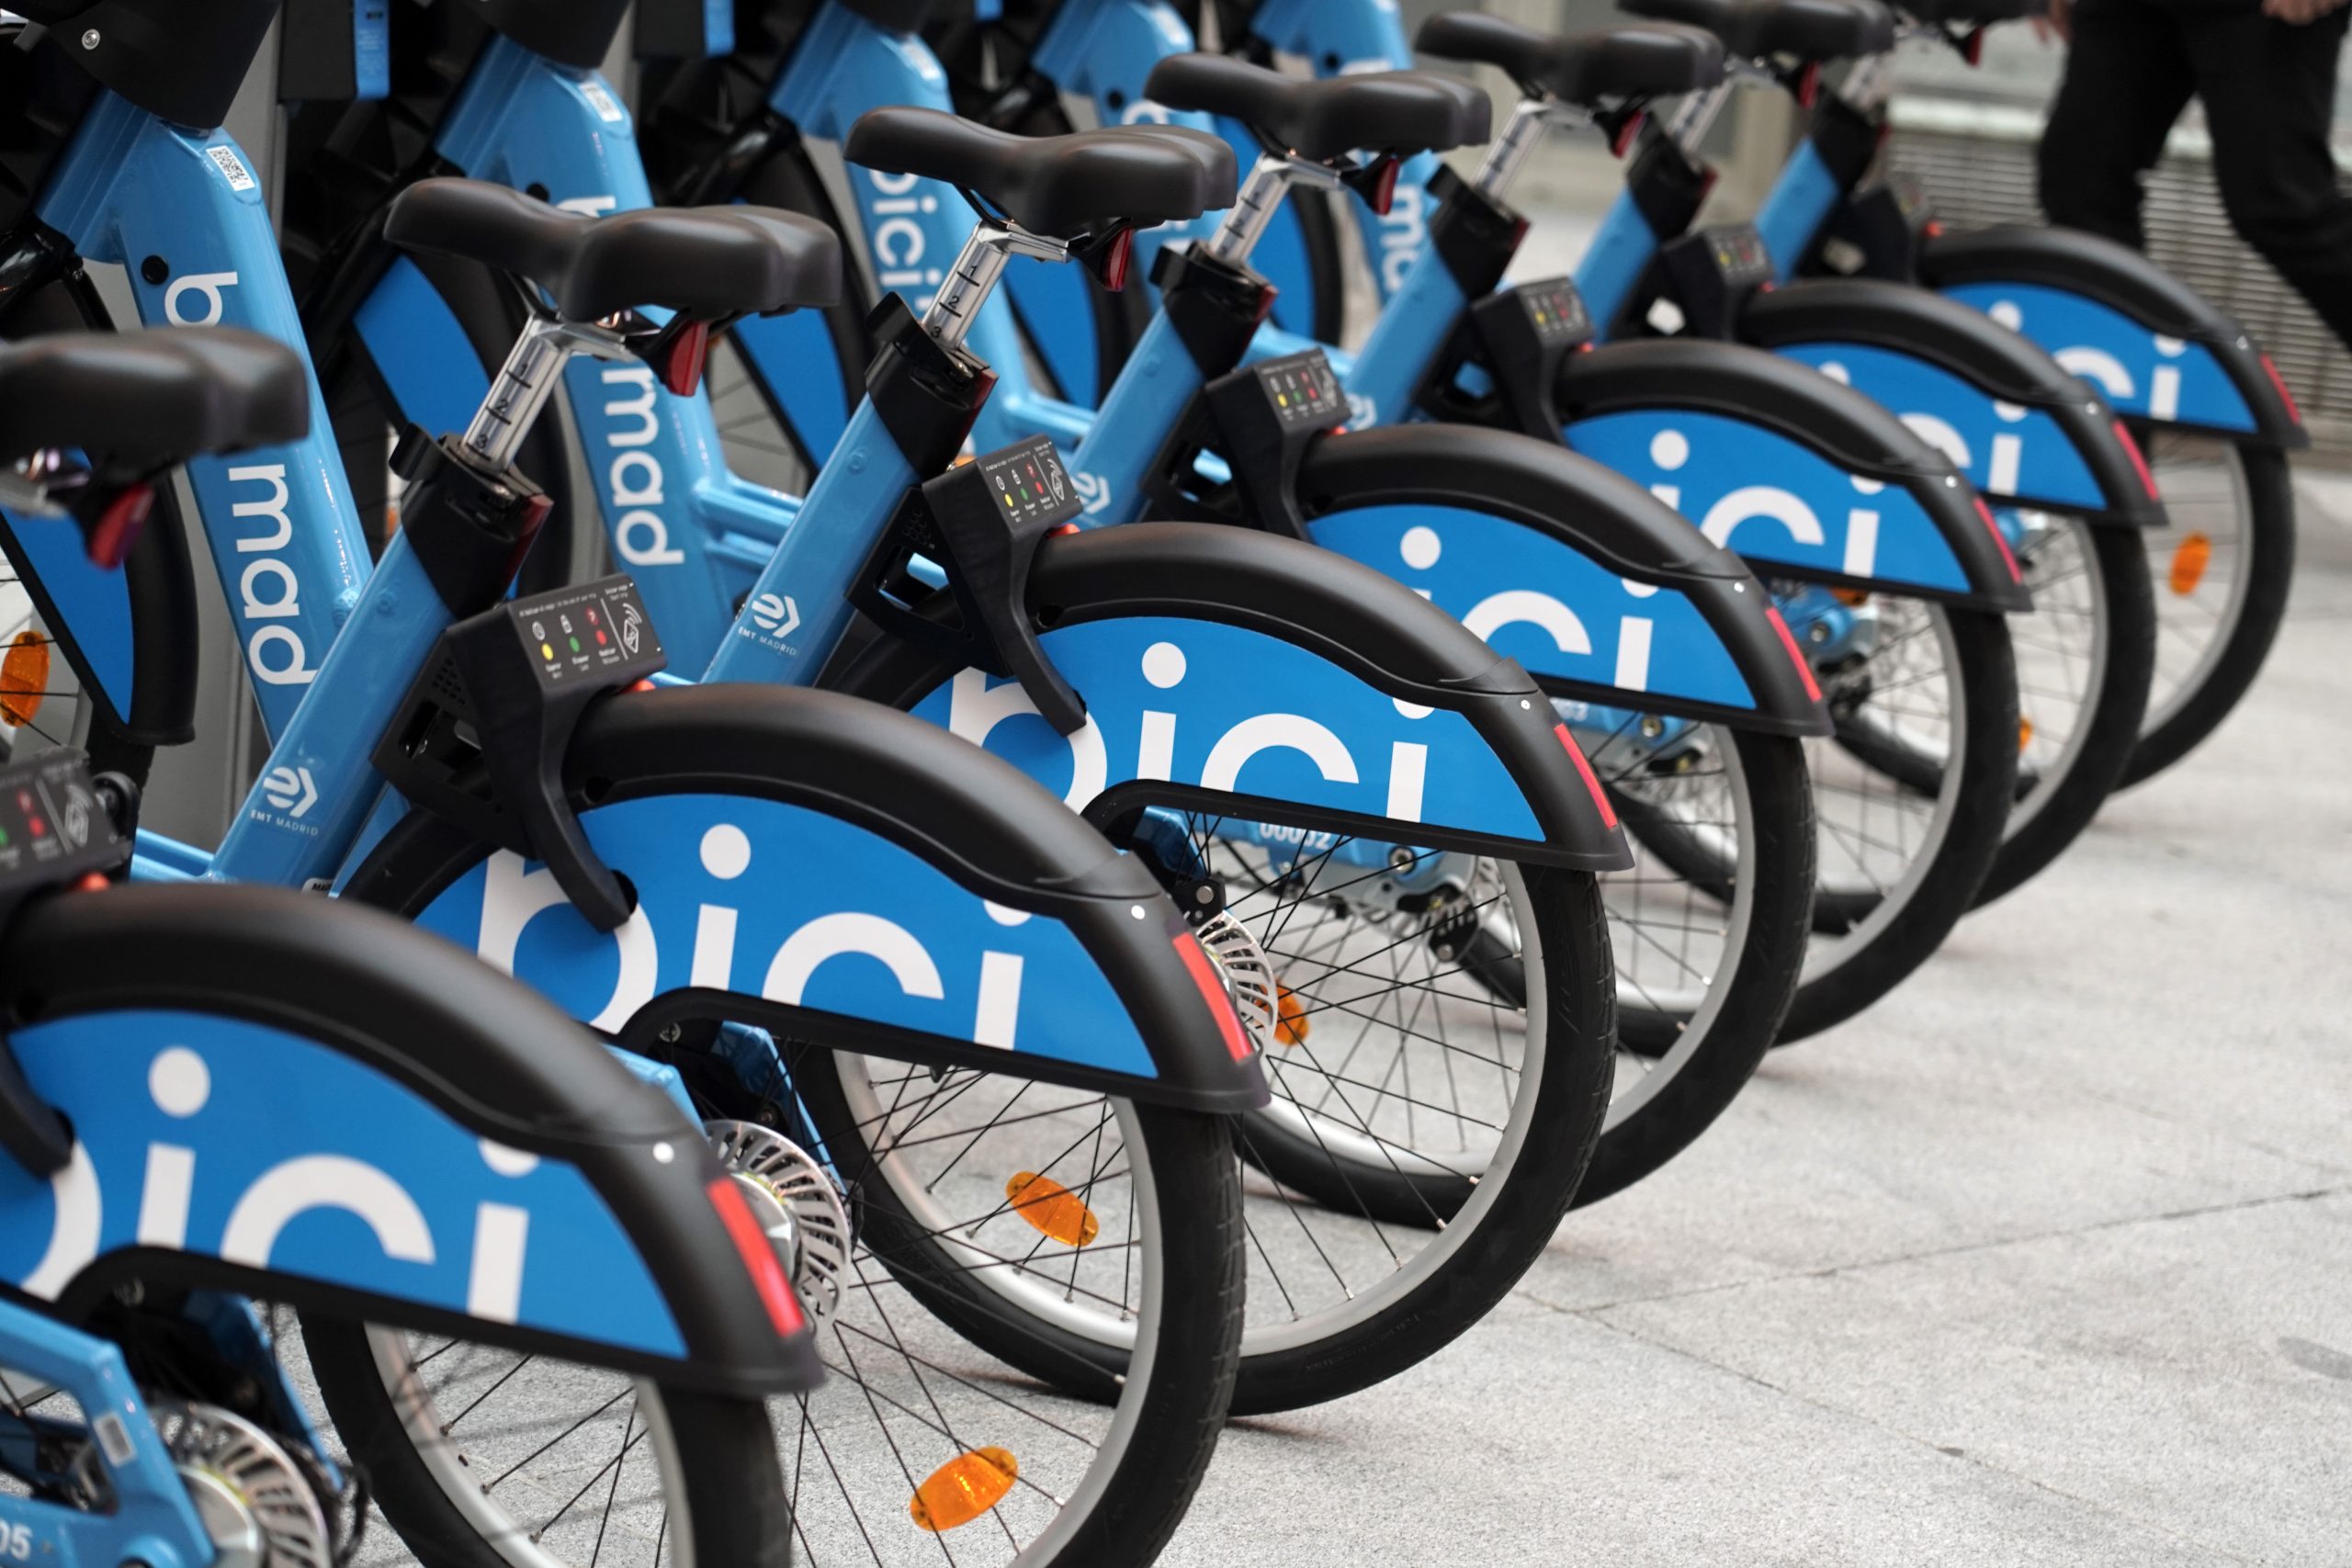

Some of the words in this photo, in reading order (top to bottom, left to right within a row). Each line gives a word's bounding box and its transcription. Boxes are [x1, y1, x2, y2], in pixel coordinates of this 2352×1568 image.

[970, 265, 978, 276] 1
[948, 295, 960, 309] 2
[738, 626, 757, 639] EMT
[759, 635, 797, 656] MADRID
[250, 809, 272, 824] EMT
[276, 817, 320, 837] MADRID
